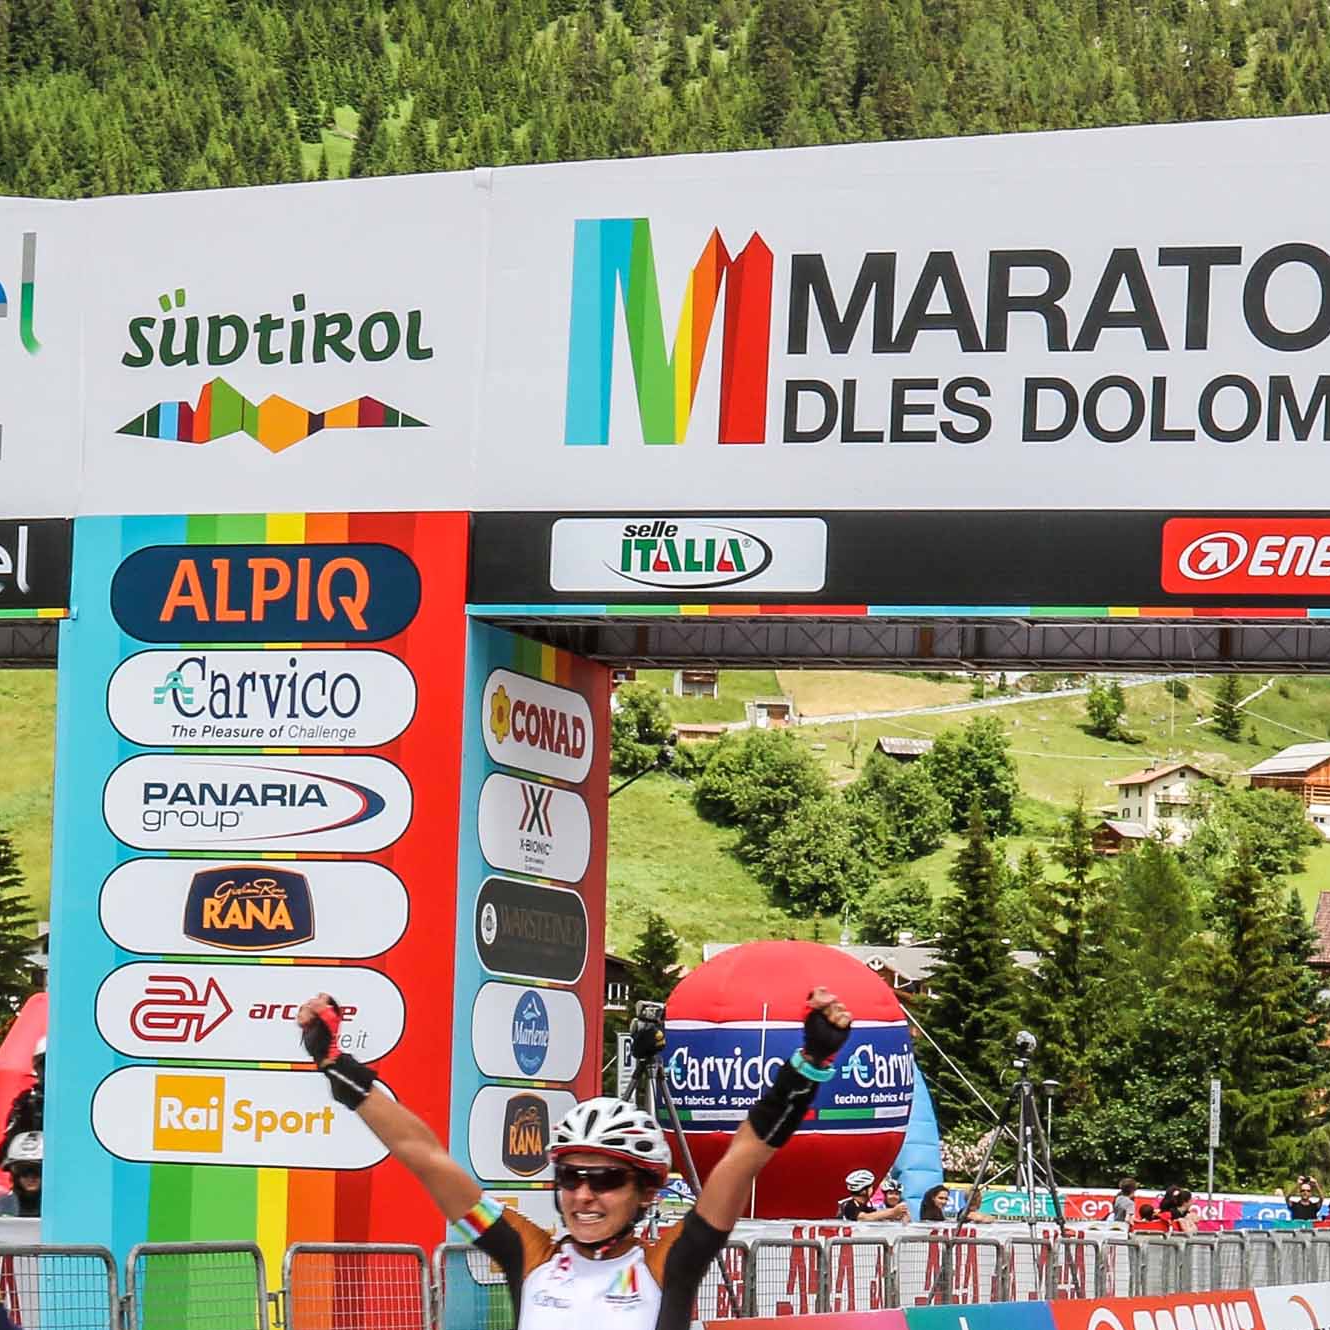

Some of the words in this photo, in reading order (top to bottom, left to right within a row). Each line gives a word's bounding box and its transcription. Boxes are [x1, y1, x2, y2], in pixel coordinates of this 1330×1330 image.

[782, 376, 991, 444] DLES
[623, 521, 678, 540] selle
[621, 537, 748, 573] ITALIA
[159, 557, 370, 630] ALPIQ
[171, 656, 361, 719] Carvico
[171, 725, 197, 738] The
[201, 725, 265, 738] Pleasure
[269, 725, 284, 738] of
[288, 725, 357, 742] Challenge
[511, 701, 586, 759] CONAD
[143, 783, 328, 807] PANARIA
[143, 808, 240, 832] group
[202, 899, 294, 931] RANA
[249, 1004, 357, 1022] arce
[513, 1021, 549, 1047] Marlene
[853, 1044, 914, 1088] Carvic
[684, 1095, 715, 1106] fabrics
[719, 1095, 728, 1105] 4
[835, 1093, 867, 1104] techno
[870, 1093, 898, 1104] fabrics
[159, 1096, 220, 1131] Rai
[232, 1099, 335, 1142] Sport
[509, 1125, 542, 1156] RANA
[994, 1190, 1050, 1215] enel
